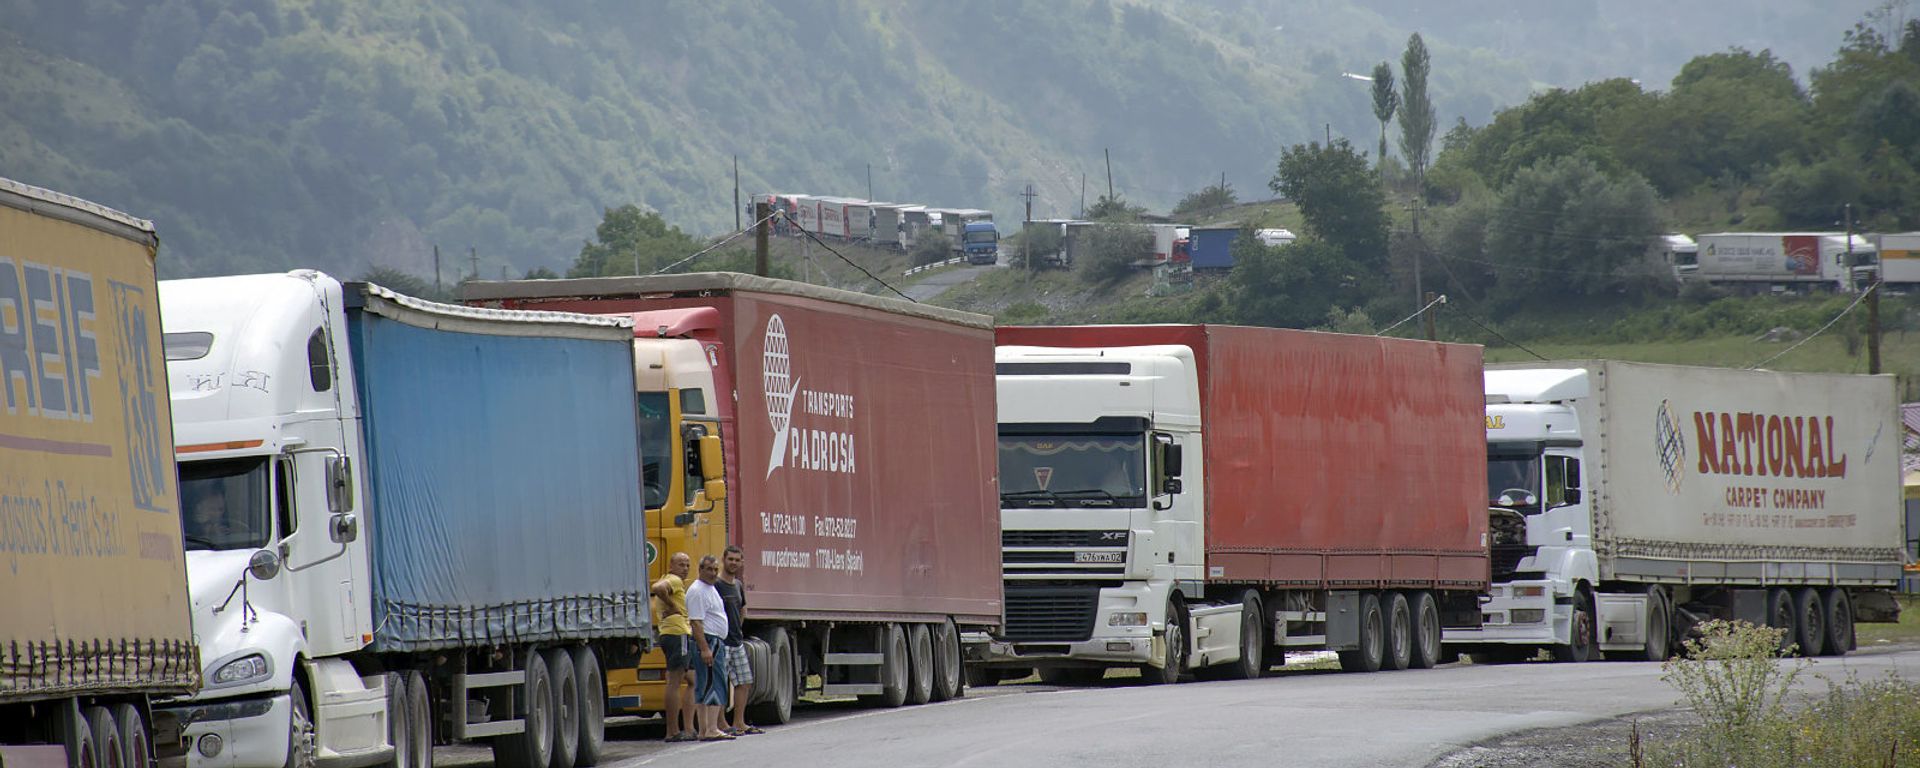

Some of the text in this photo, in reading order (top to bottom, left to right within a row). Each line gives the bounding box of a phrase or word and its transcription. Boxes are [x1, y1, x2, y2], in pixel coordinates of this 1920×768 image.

[0, 256, 100, 423] REIF
[803, 390, 853, 419] TRANSPORTS
[792, 428, 855, 473] PADROSA
[1694, 411, 1847, 479] NATIONAL
[57, 479, 93, 557] Rent
[1726, 486, 1825, 509] CARPET COMPANY
[1101, 532, 1127, 540] XF
